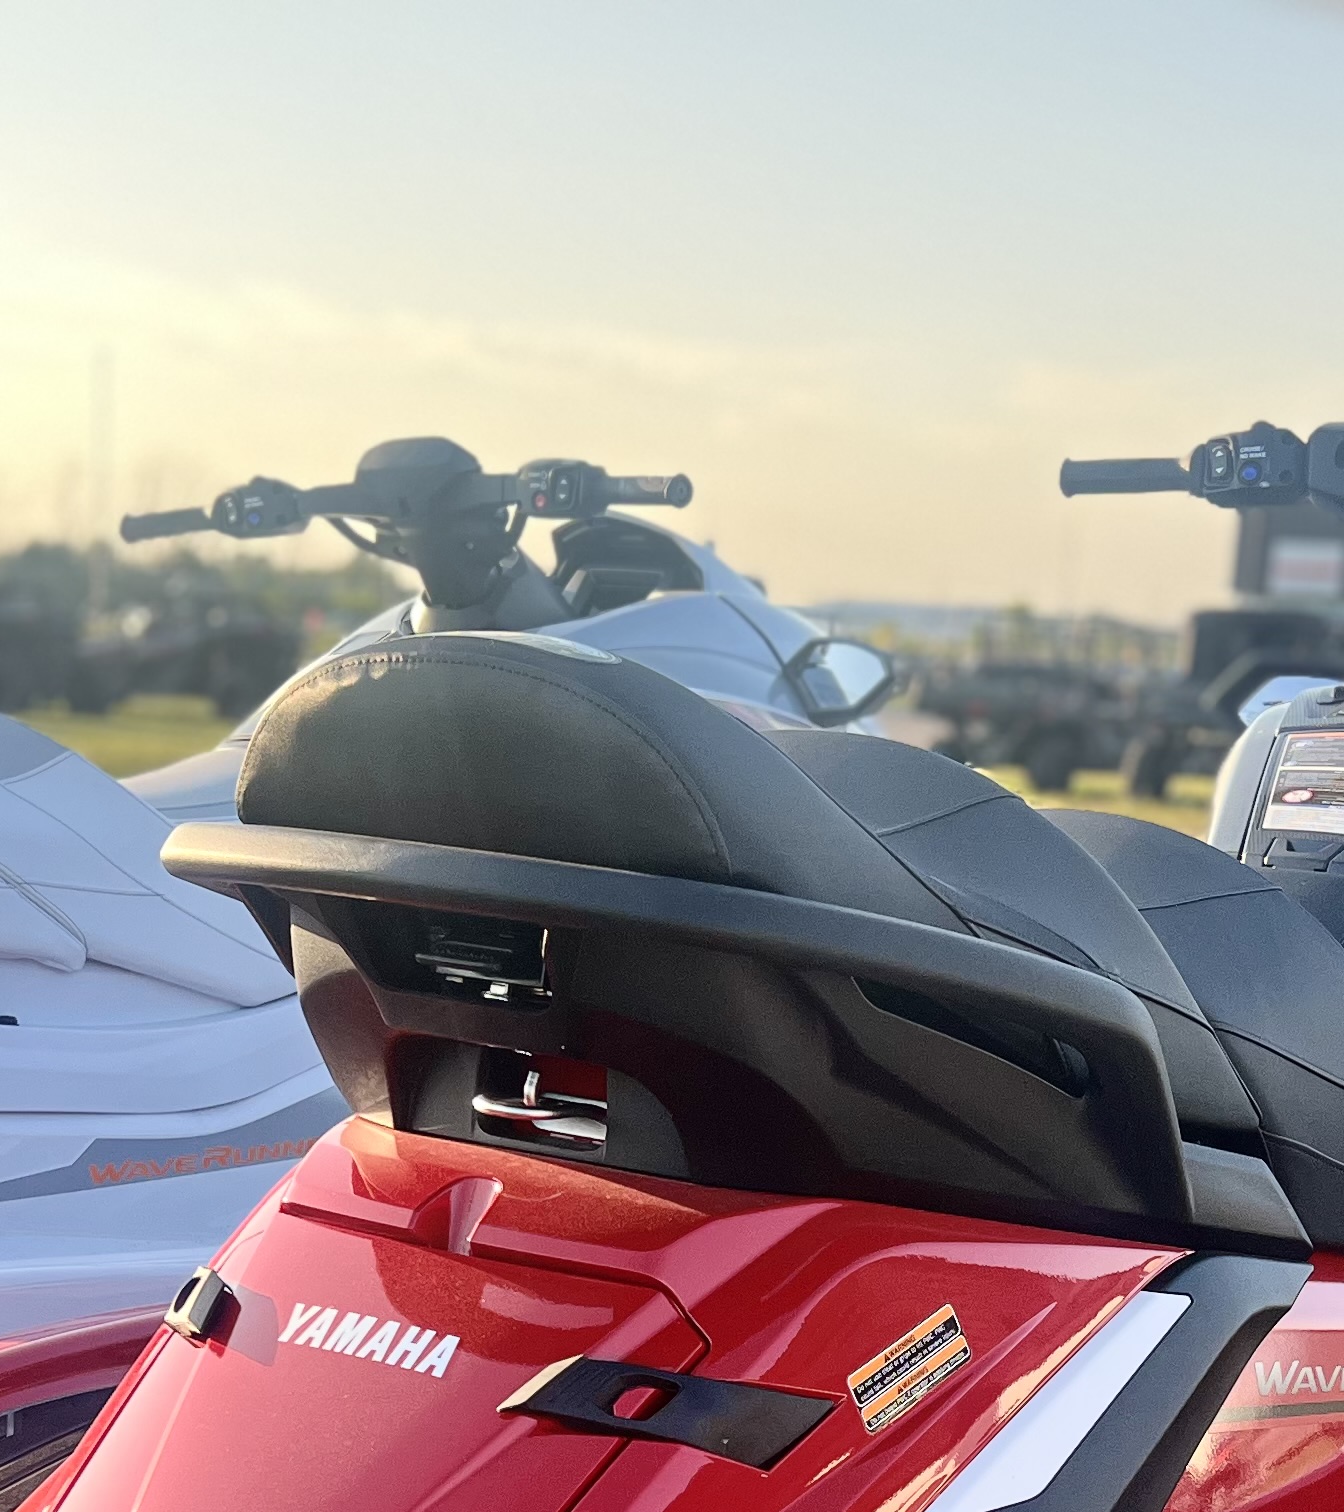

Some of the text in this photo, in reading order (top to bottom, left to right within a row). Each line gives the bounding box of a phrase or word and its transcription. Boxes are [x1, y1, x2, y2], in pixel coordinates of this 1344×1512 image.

[278, 1302, 460, 1378] YAMAHA
[888, 1333, 915, 1358] WARNING
[902, 1365, 928, 1389] WARNING
